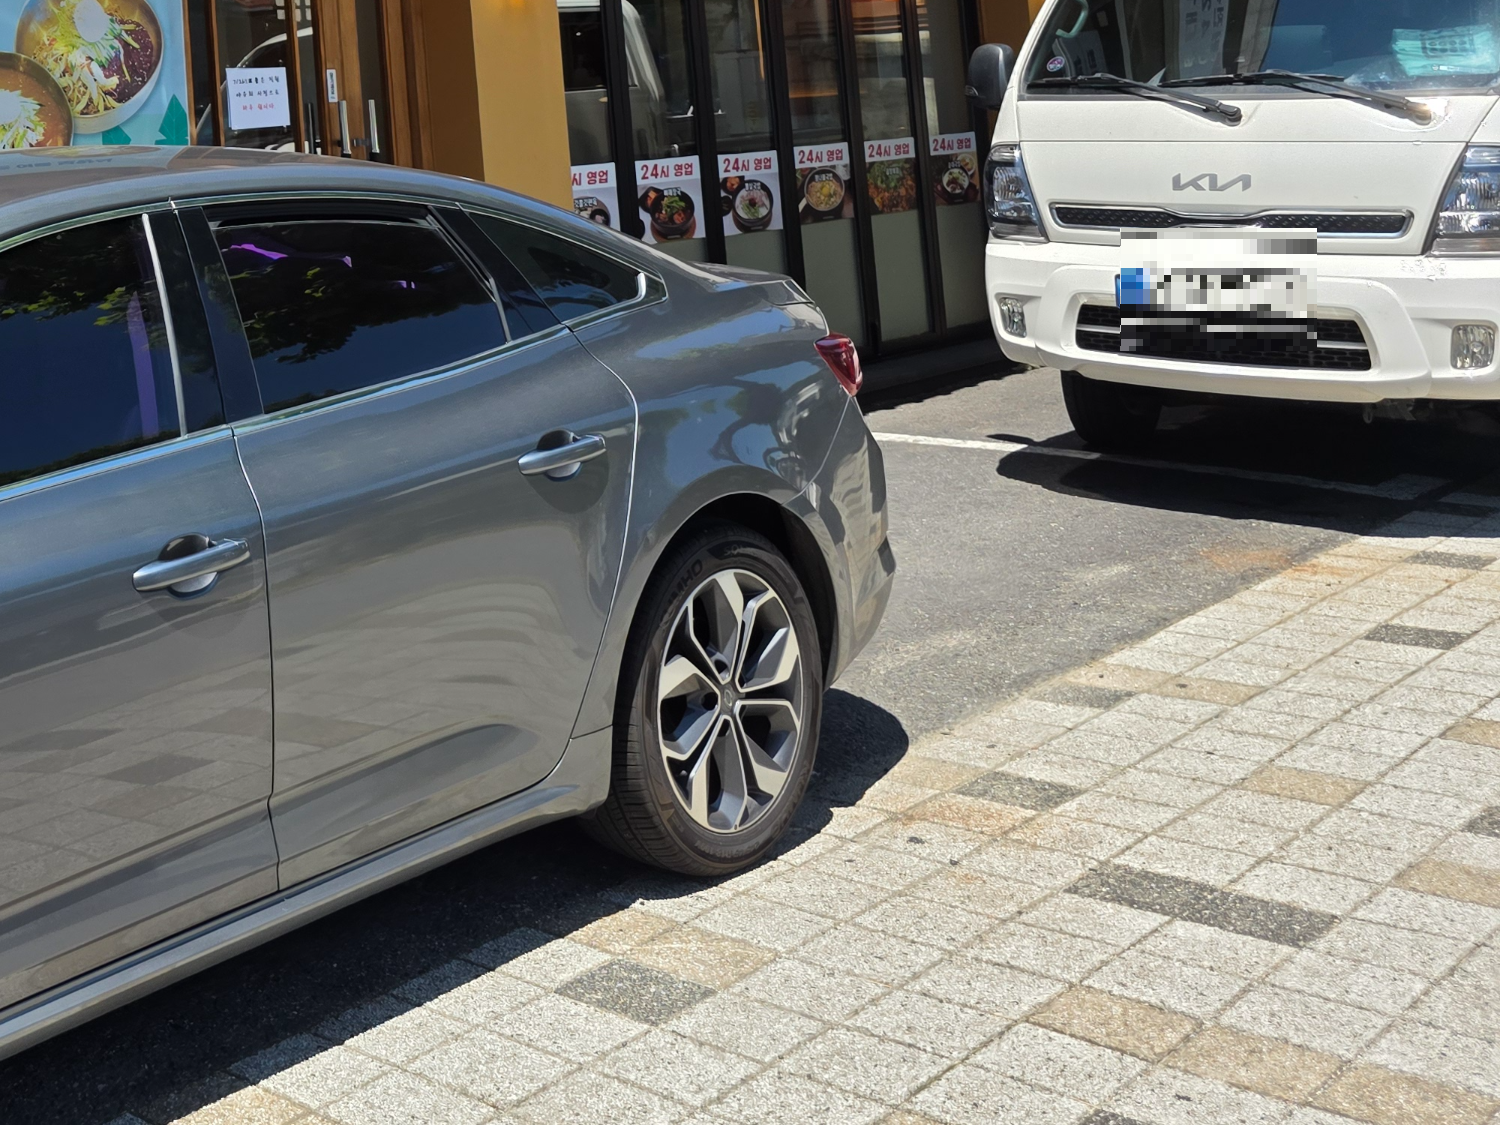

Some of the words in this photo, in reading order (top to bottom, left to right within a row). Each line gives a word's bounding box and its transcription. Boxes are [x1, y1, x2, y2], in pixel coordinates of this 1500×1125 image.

[868, 143, 891, 158] 24시
[894, 143, 910, 156] 영업
[932, 138, 954, 152] 24시
[957, 137, 972, 150] 영업
[798, 149, 823, 165] 24시
[827, 148, 844, 162] 영업
[641, 163, 670, 180] 24시
[674, 162, 694, 177] 영업
[723, 157, 750, 173] 24시
[754, 157, 772, 171] 영업
[586, 169, 609, 185] 영업
